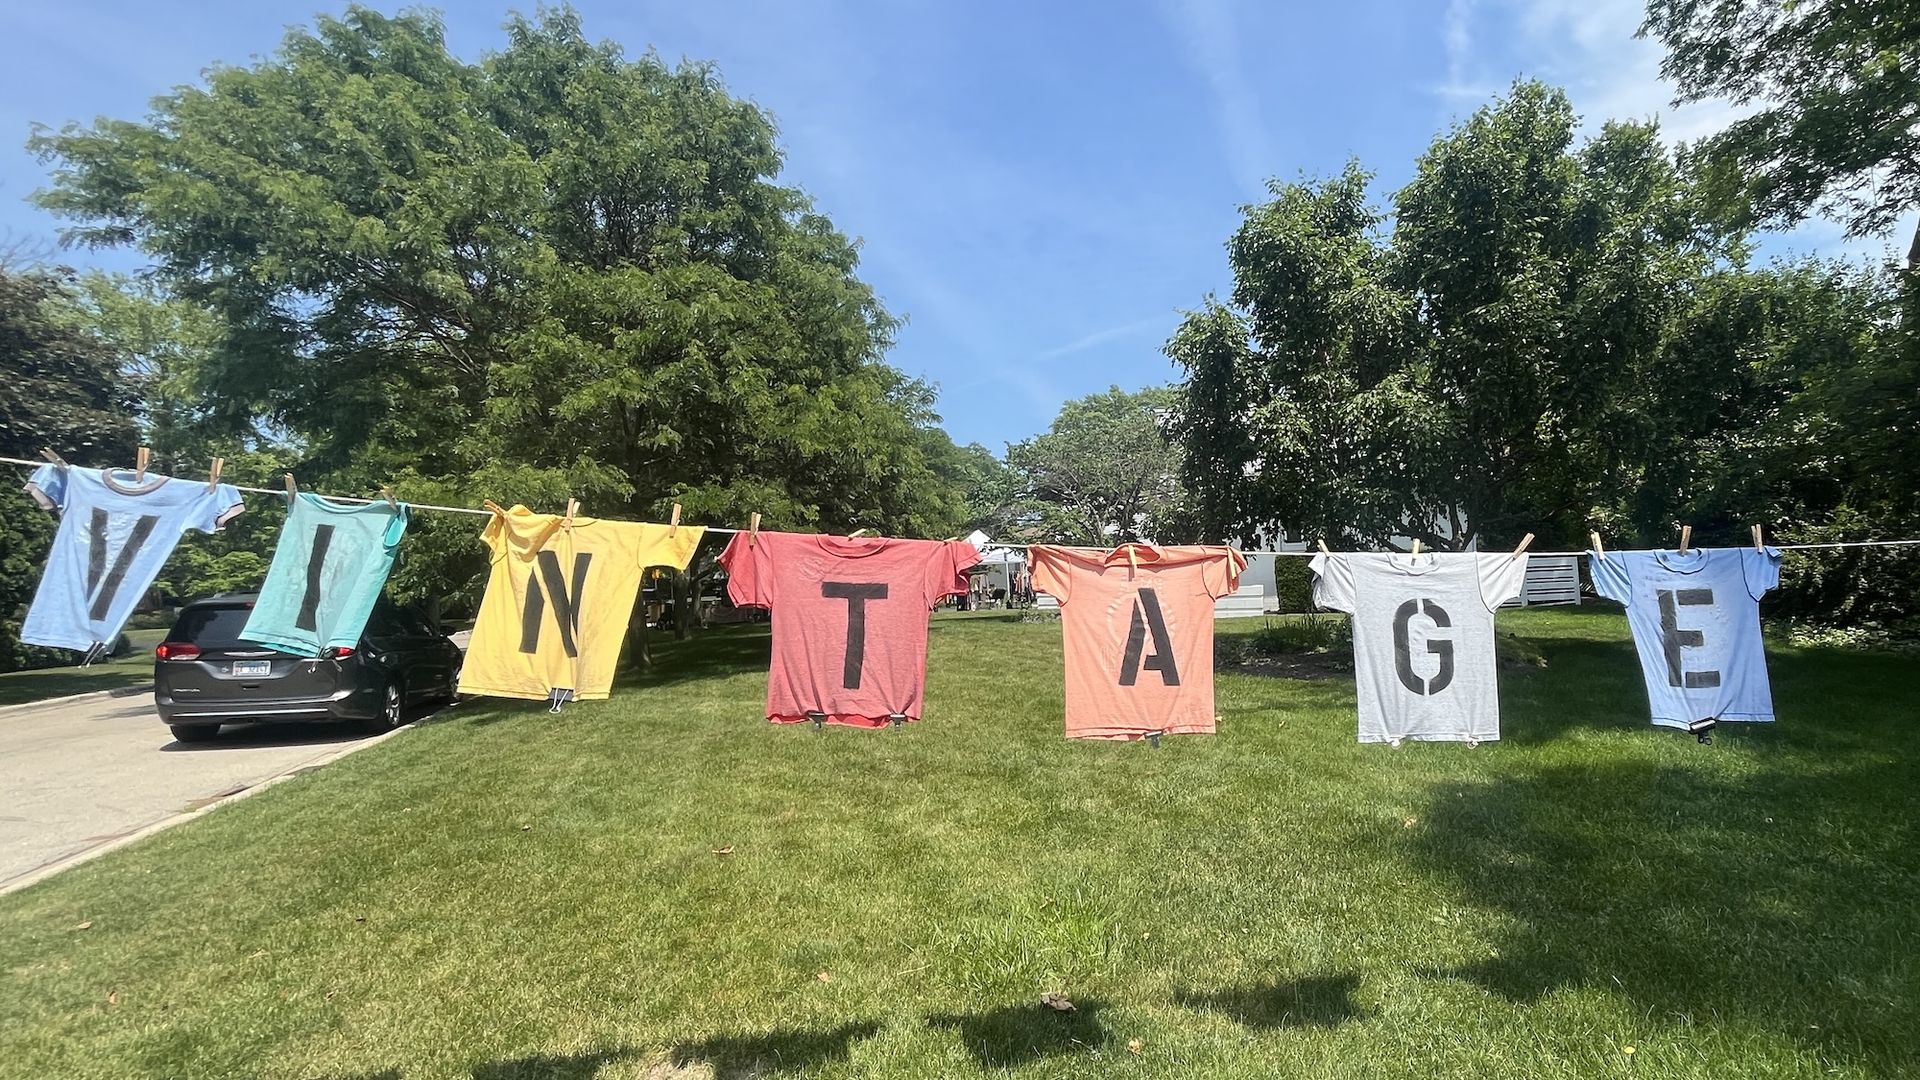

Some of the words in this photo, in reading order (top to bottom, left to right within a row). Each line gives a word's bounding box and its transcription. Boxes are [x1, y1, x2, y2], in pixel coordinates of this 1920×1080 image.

[87, 507, 161, 621] V
[519, 550, 592, 658] N
[821, 581, 889, 689] T
[1118, 588, 1180, 686] A
[1393, 598, 1454, 696] G
[1656, 588, 1720, 688] E
